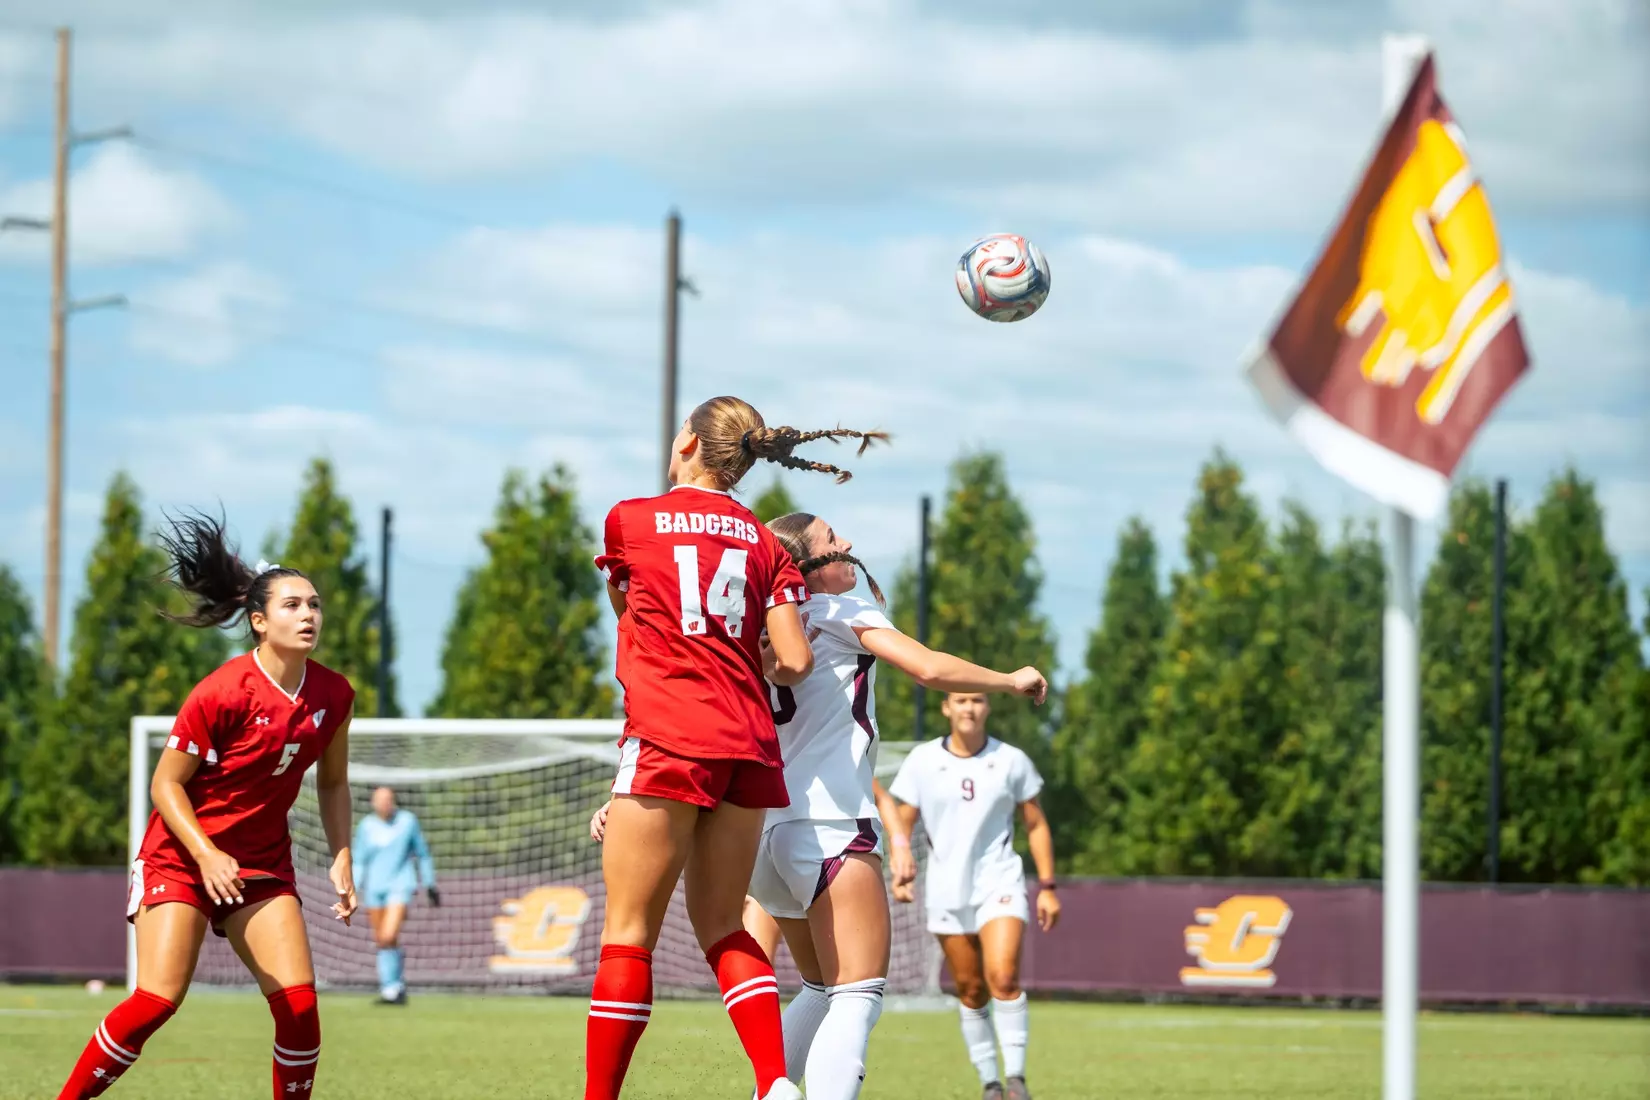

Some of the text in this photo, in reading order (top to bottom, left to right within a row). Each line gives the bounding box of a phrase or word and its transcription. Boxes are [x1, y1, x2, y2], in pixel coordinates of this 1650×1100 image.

[655, 512, 759, 544] BADGERS
[673, 545, 748, 638] 14
[271, 743, 301, 776] 5
[961, 777, 975, 801] 9
[1179, 894, 1293, 987] C
